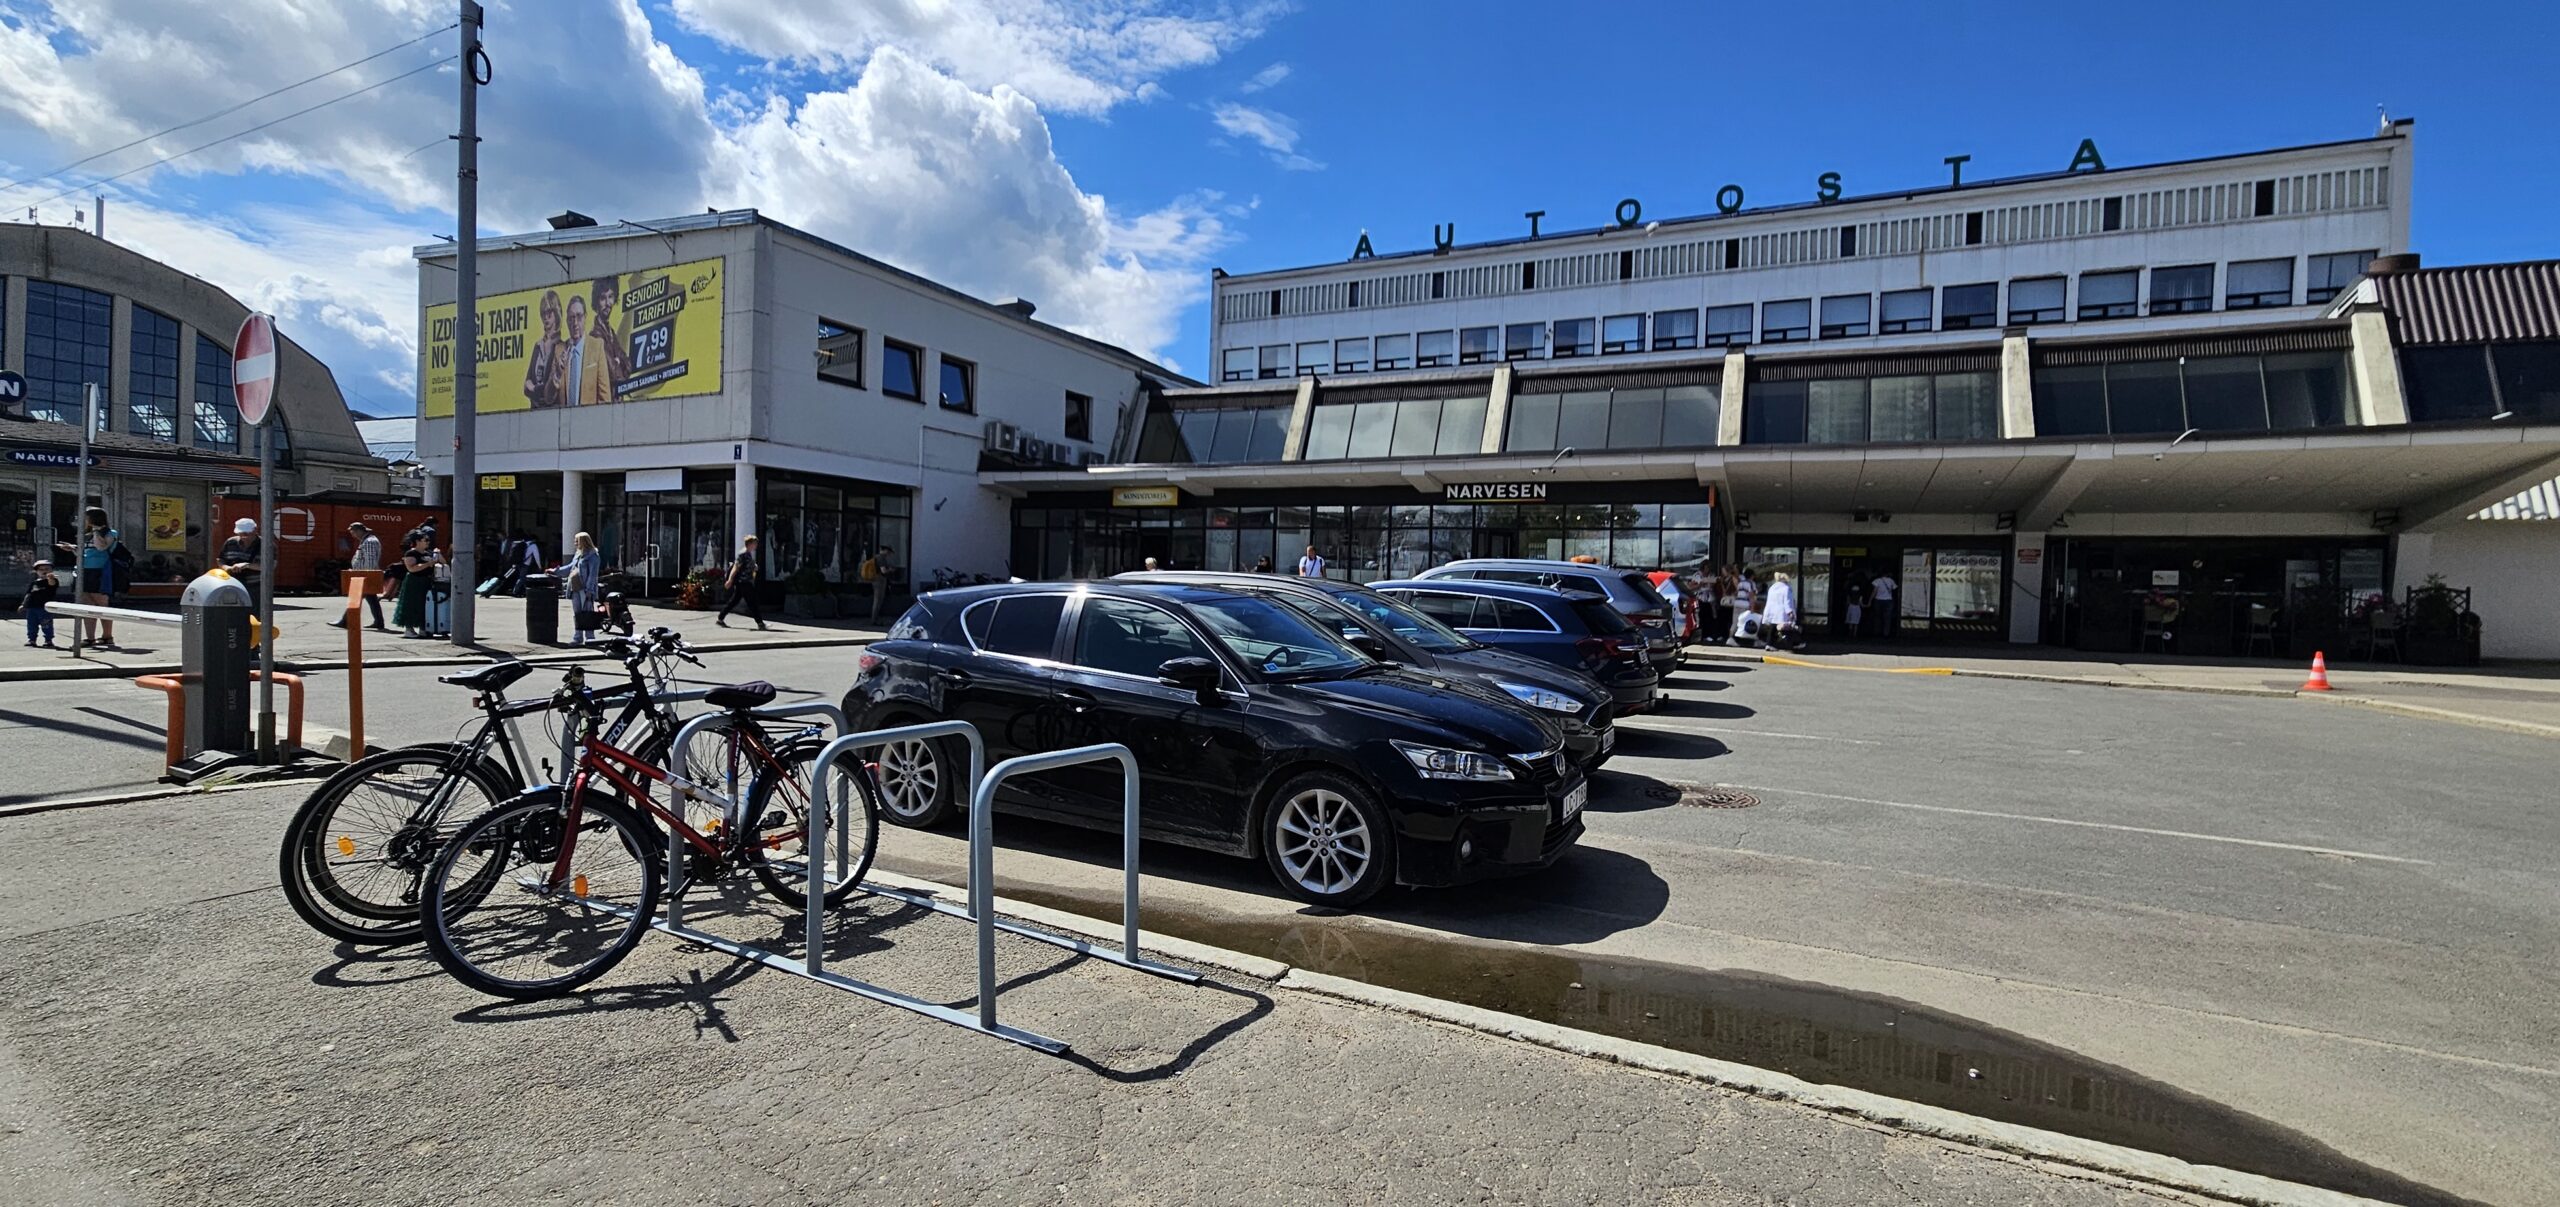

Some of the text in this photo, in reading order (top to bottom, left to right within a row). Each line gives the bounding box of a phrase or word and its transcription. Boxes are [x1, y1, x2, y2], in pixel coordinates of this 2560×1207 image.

[625, 279, 666, 307] SENIORU
[488, 305, 528, 335] TARIFI
[638, 296, 681, 324] TARIFI NO
[431, 344, 449, 369] NO
[634, 326, 668, 369] 7,99
[1446, 483, 1547, 498] NARVESEN
[362, 513, 402, 522] omniva
